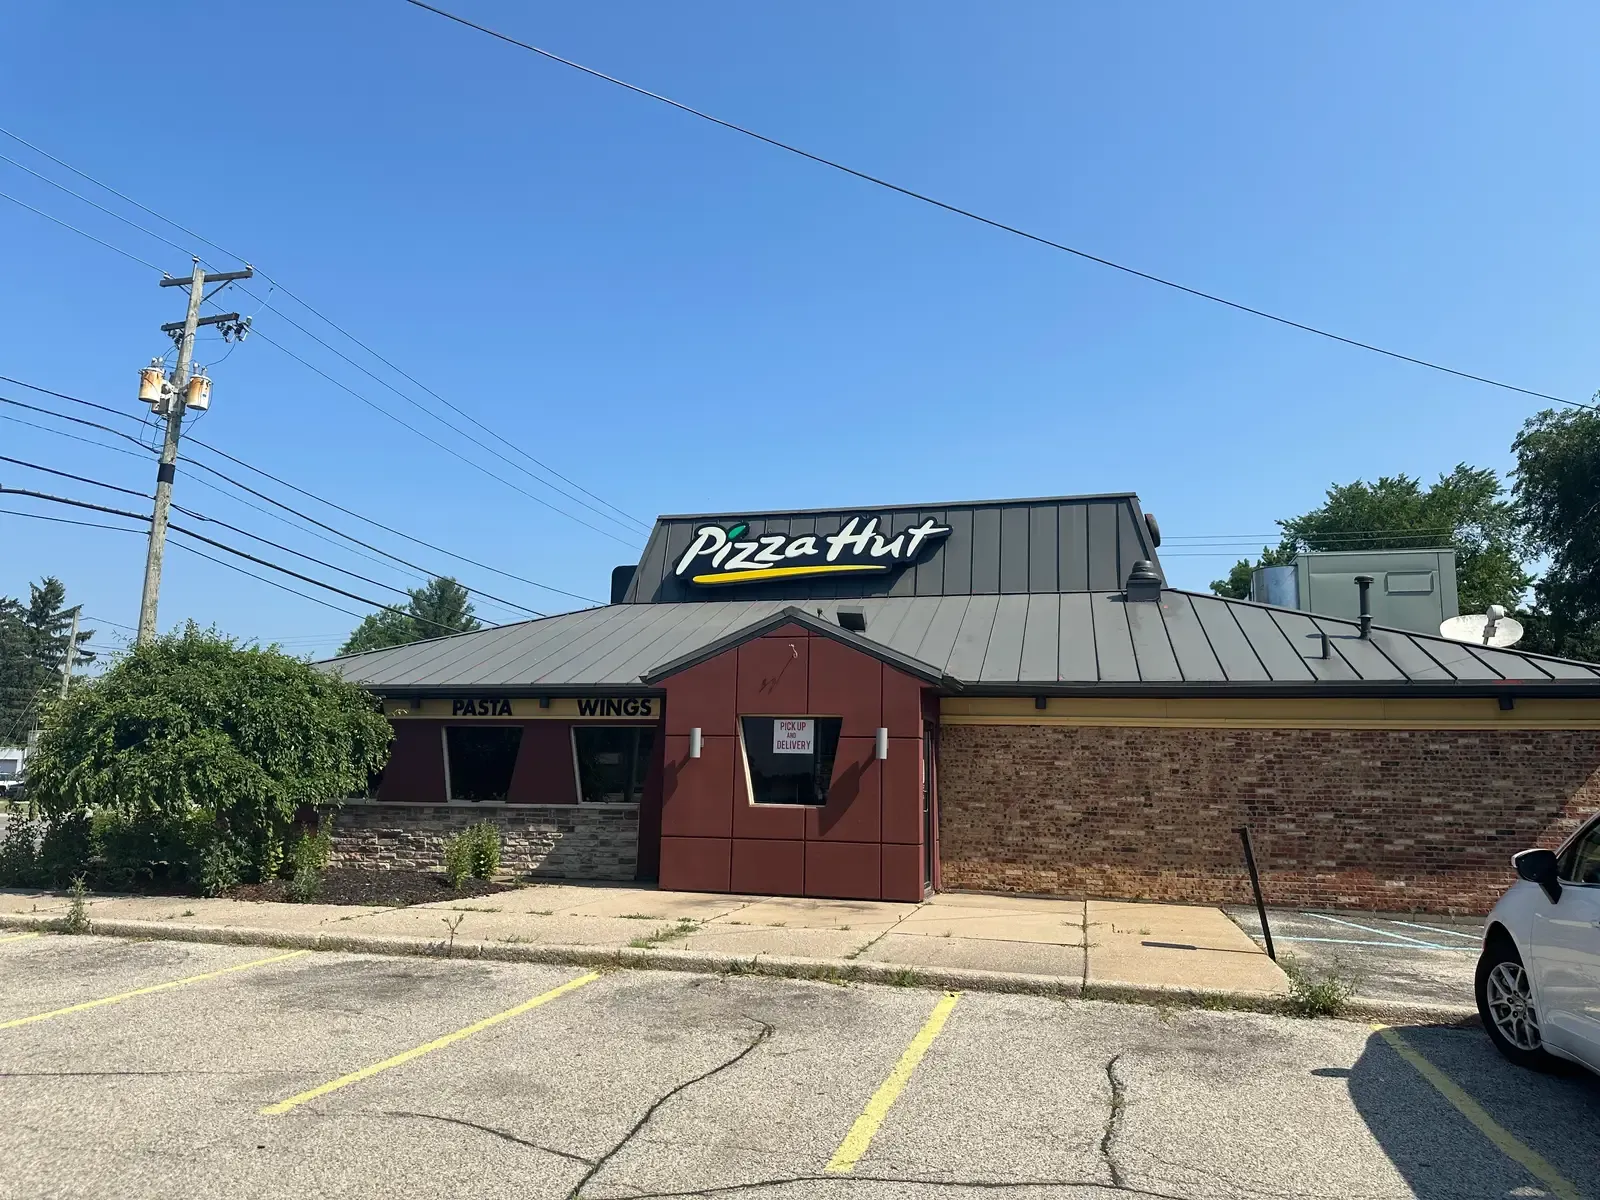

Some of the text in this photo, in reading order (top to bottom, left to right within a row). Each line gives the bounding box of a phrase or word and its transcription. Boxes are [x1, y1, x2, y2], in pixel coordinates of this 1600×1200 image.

[676, 517, 950, 576] Pizza Hut
[452, 699, 513, 716] PASTA
[577, 699, 652, 717] WINGS
[780, 721, 806, 731] PICK UP
[777, 740, 810, 750] DELIVERY
